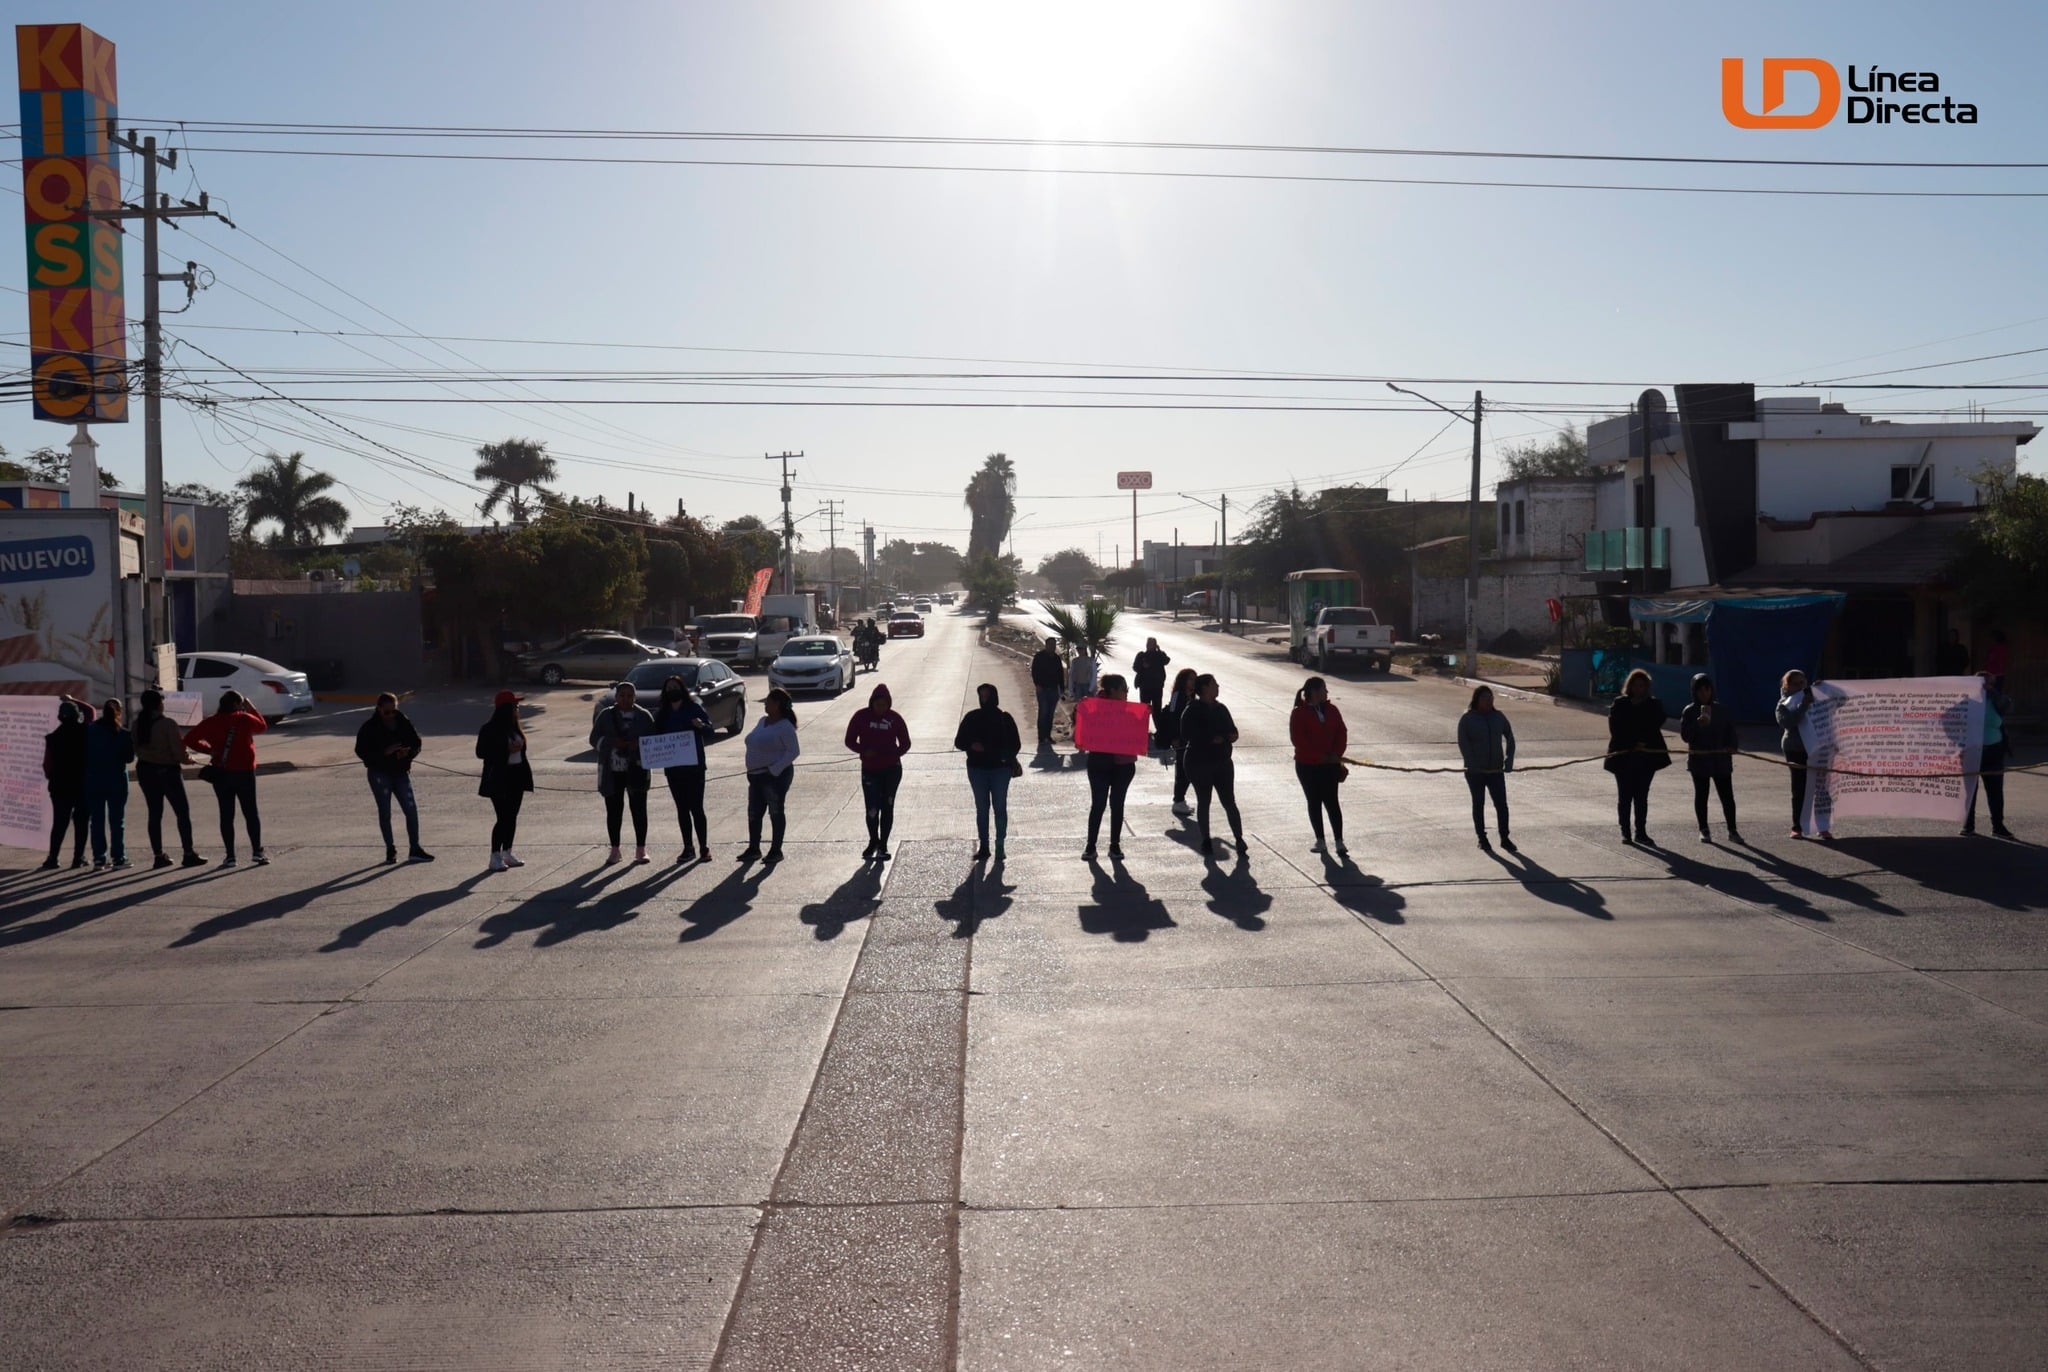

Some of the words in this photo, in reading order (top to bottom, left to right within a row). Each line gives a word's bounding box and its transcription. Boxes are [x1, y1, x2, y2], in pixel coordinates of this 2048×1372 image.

[17, 24, 95, 419] KIOSKO
[1119, 475, 1151, 486] OXXO
[1864, 725, 1900, 733] ELÉCTRICA
[1944, 791, 1960, 799] QUE
